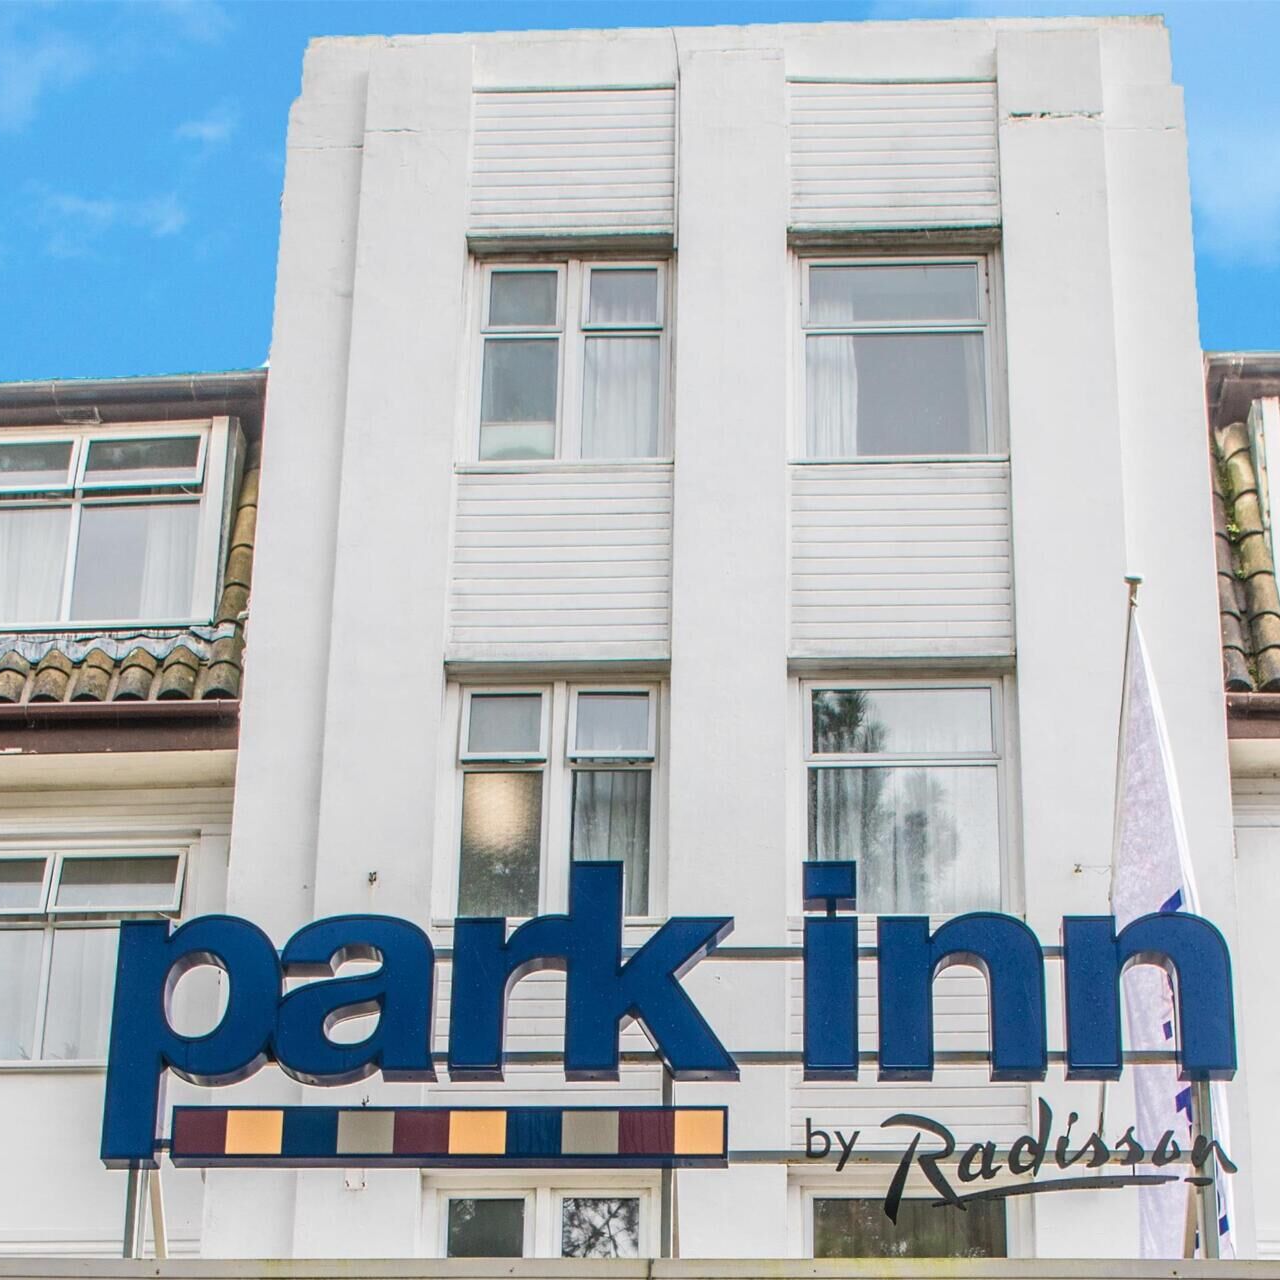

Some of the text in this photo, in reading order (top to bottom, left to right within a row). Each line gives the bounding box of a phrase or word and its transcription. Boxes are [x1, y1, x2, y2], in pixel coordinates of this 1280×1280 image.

[101, 860, 1237, 1170] park inn
[805, 1117, 860, 1172] by
[880, 1096, 1238, 1226] Radisson
